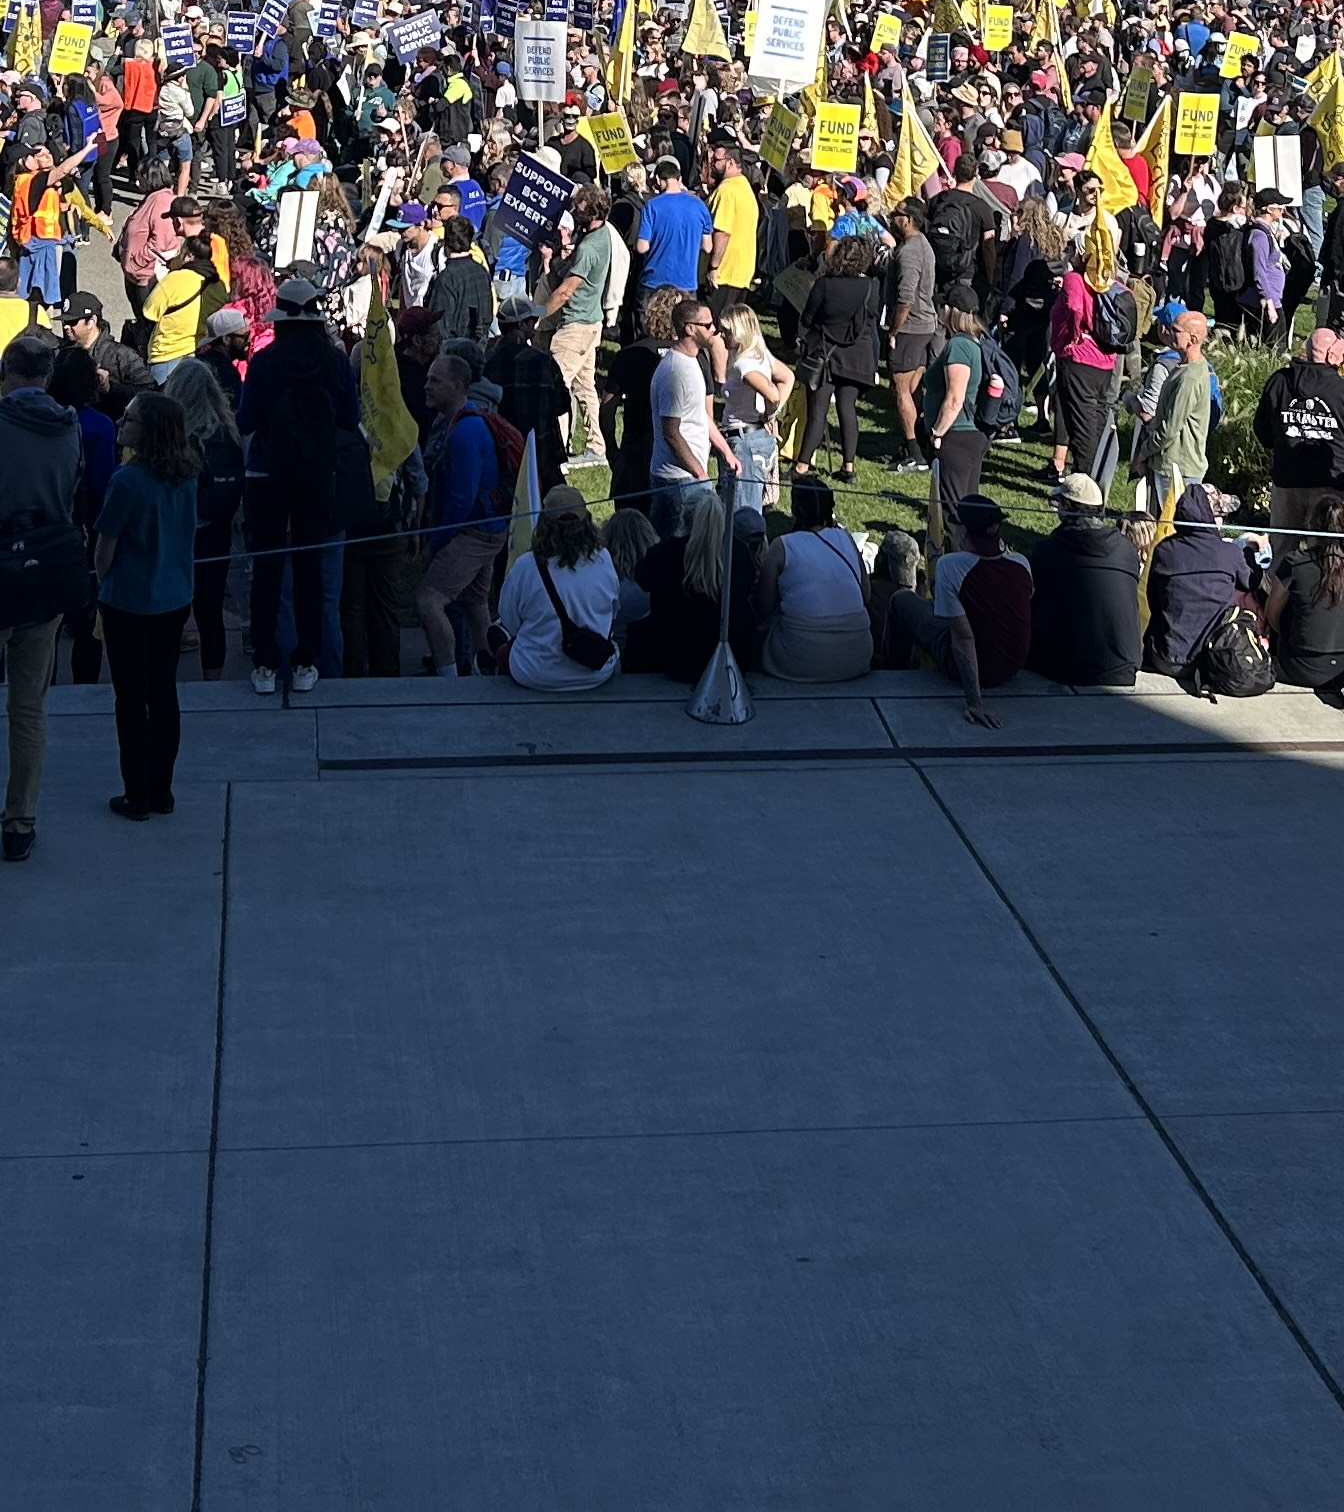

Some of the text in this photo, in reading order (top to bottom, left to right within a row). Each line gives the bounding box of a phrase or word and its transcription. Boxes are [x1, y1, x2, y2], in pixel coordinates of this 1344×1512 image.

[393, 14, 433, 36] PROTECT
[772, 15, 805, 28] DEFEND
[400, 25, 433, 45] PUBLIC
[772, 26, 802, 40] PUBLIC
[58, 34, 86, 49] FUND
[398, 31, 441, 54] SERVICES
[766, 38, 805, 52] SERVICES
[526, 46, 551, 54] DEFEND
[527, 56, 551, 65] PUBLIC
[524, 66, 554, 75] SERVICES
[1182, 109, 1214, 122] FUND
[595, 127, 625, 143] FUND
[820, 120, 854, 135] FUND
[514, 161, 568, 201] SUPPORT
[521, 185, 549, 209] BC'S
[503, 193, 554, 231] EXPERTS
[1280, 410, 1339, 429] TEAMSTER
